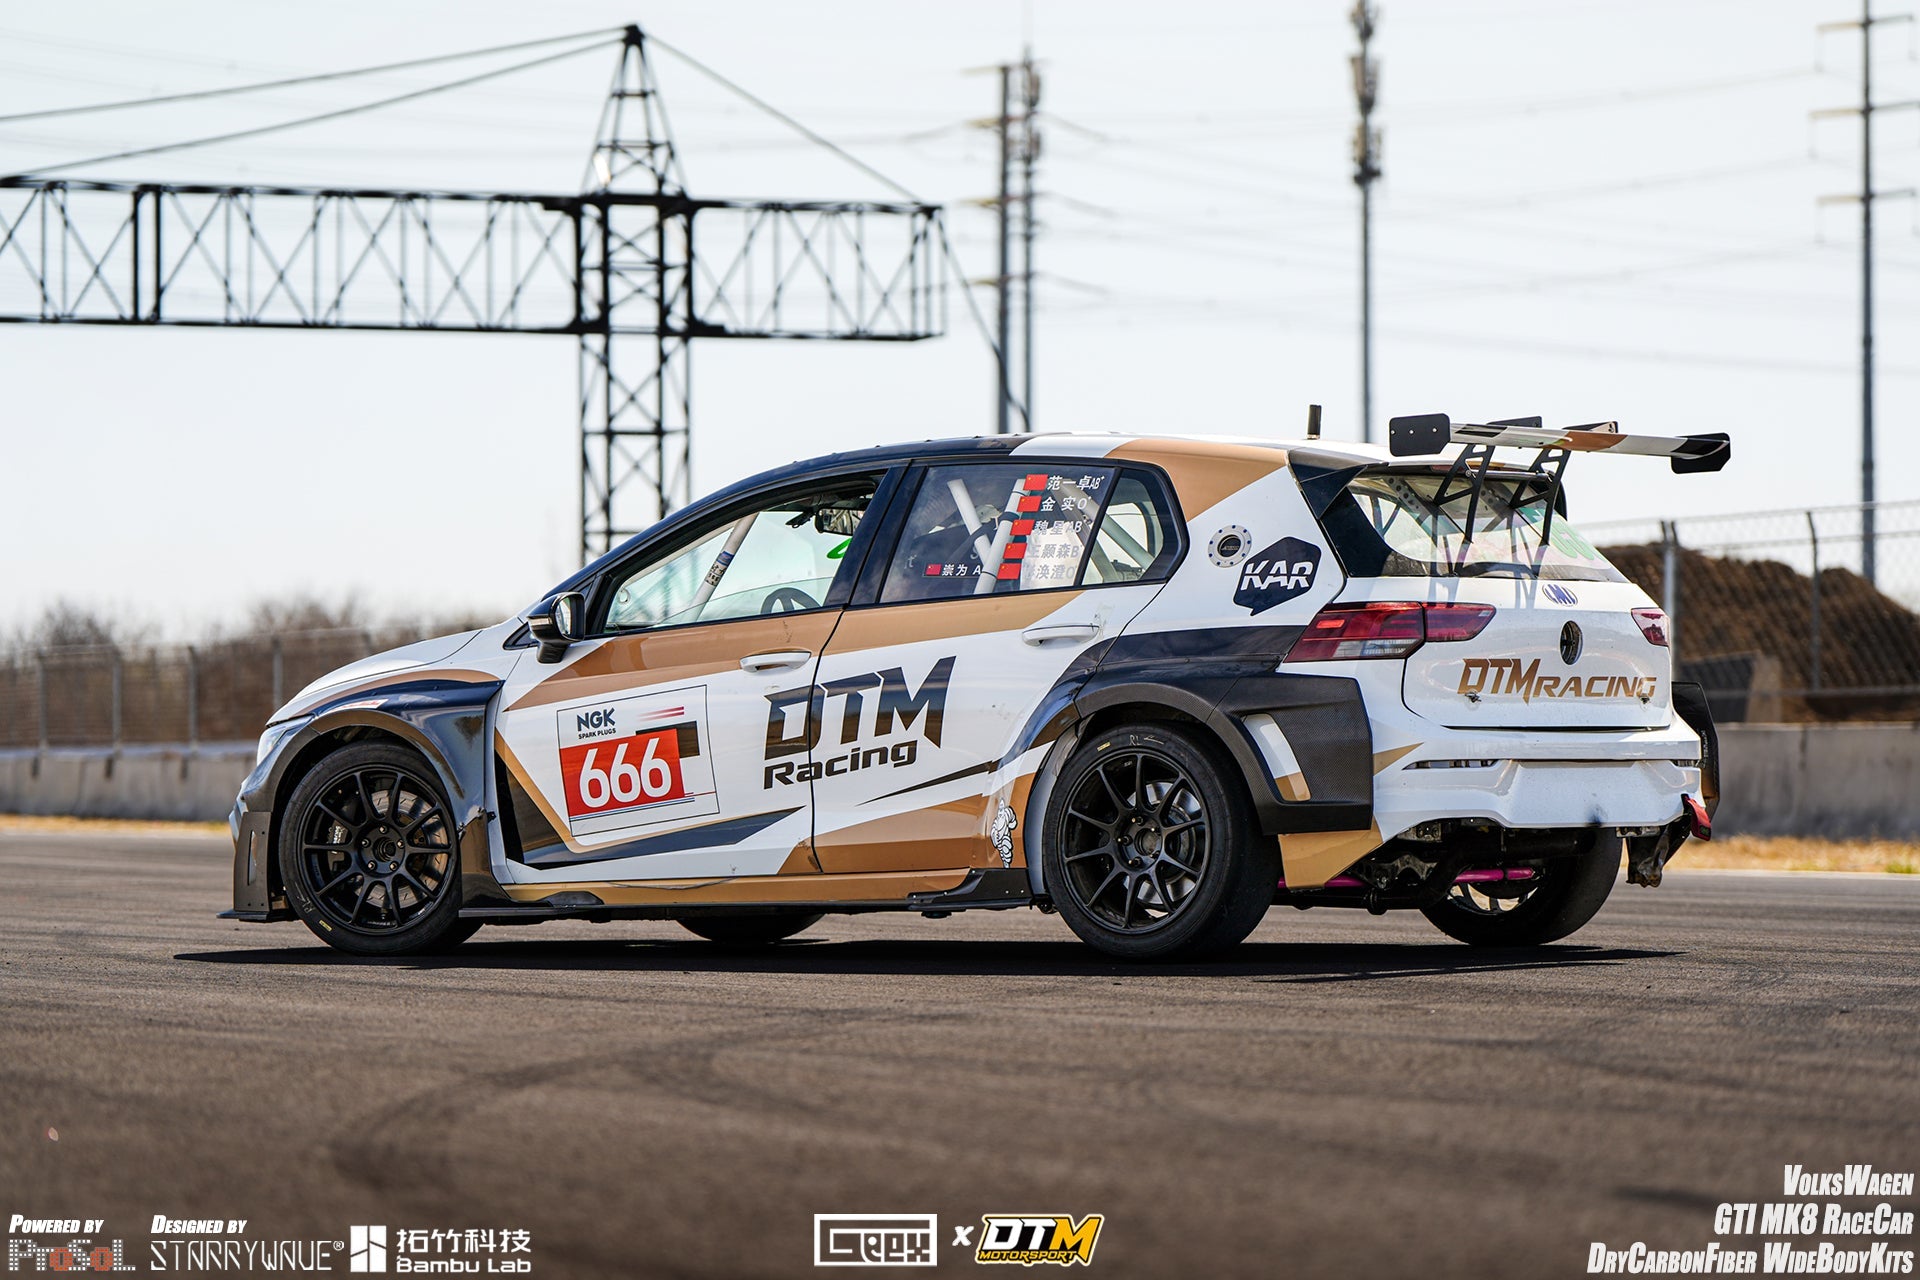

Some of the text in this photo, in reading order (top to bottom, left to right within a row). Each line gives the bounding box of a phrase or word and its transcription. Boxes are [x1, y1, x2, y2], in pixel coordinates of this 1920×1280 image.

[1240, 559, 1314, 591] KAR
[576, 707, 616, 732] NGK
[763, 655, 957, 761] DTM
[578, 728, 617, 740] SPARK PLUGS
[579, 737, 672, 809] 666
[763, 739, 918, 790] Racing
